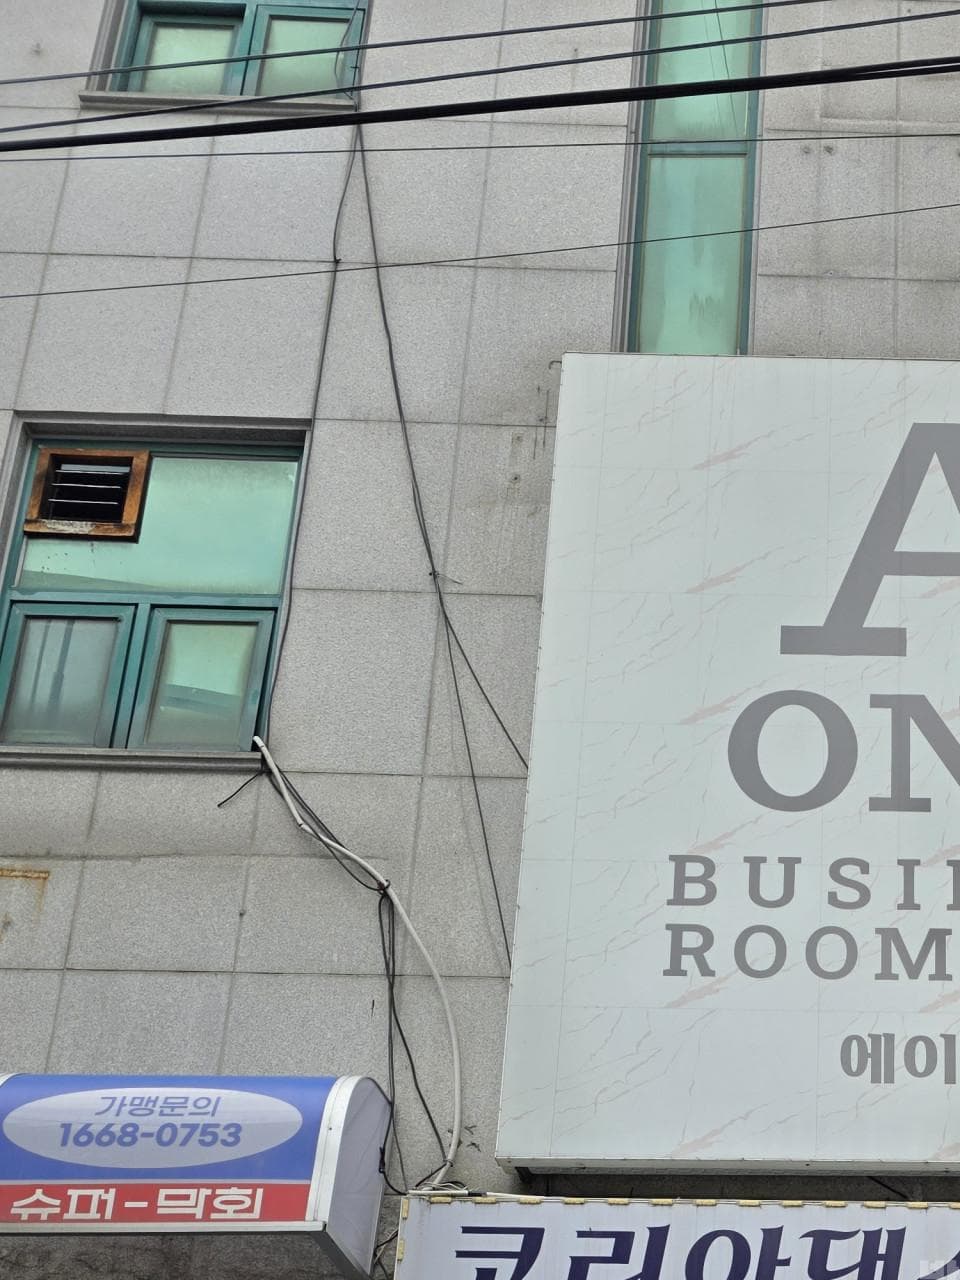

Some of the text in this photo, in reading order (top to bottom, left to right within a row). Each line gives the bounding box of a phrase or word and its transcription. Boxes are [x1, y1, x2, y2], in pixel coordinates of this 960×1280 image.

[95, 1095, 222, 1118] 가맹문의
[59, 1122, 243, 1148] 1668-0753
[10, 1187, 264, 1221] 슈퍼-막회
